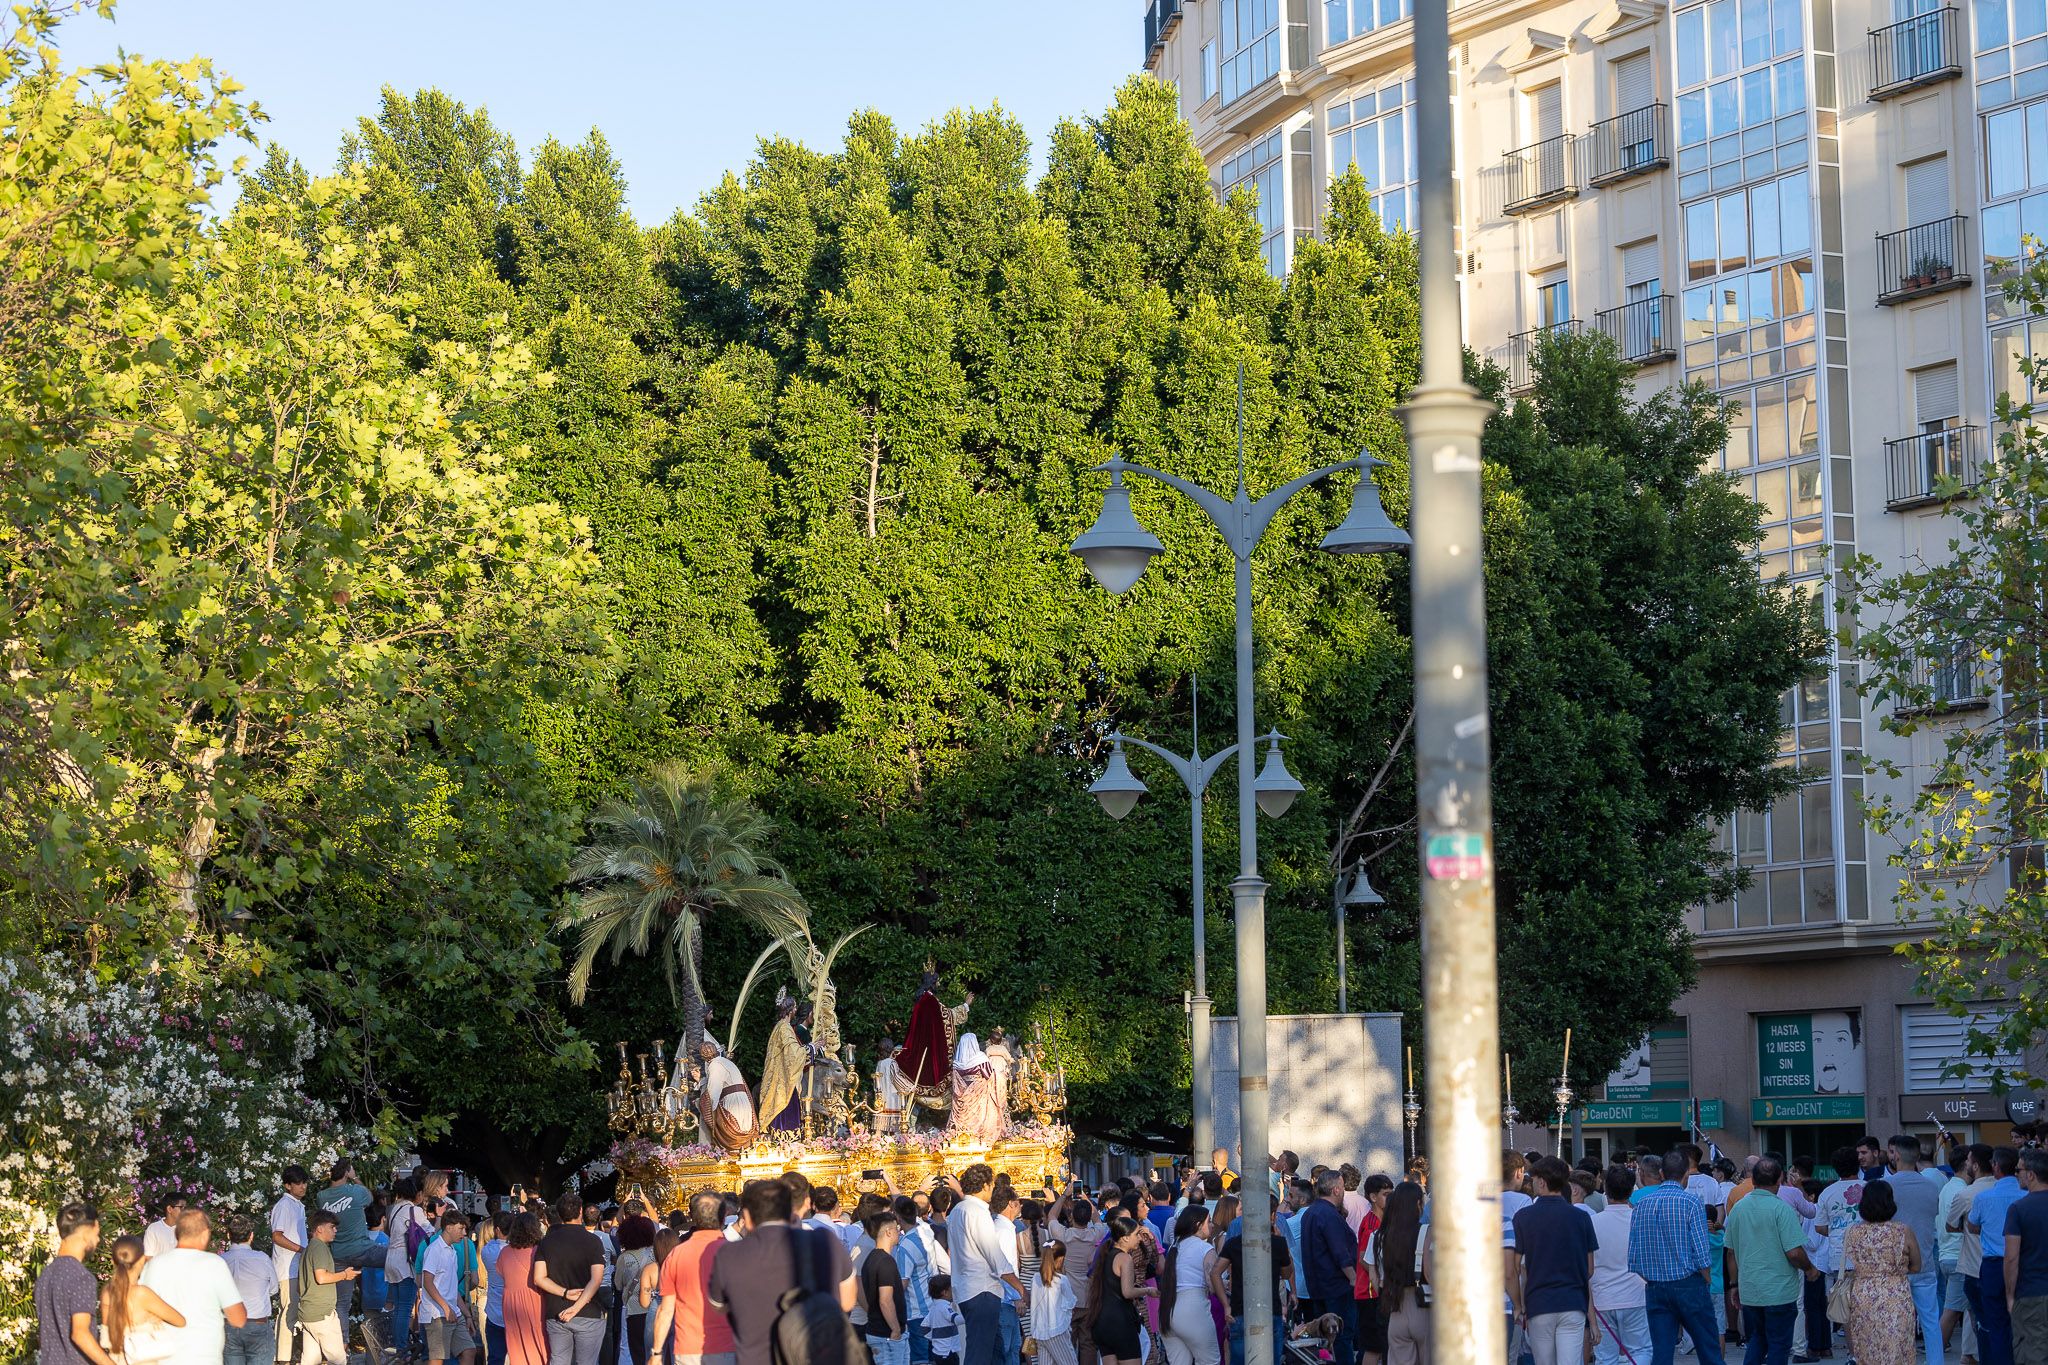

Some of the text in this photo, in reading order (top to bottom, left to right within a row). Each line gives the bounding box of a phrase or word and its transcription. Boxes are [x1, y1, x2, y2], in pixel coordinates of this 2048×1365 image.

[1771, 1025, 1799, 1036] HASTA
[1766, 1041, 1806, 1053] 12 MESES
[1779, 1058, 1793, 1070] SIN
[1763, 1074, 1810, 1087] INTERESES
[1590, 1107, 1633, 1119] CareDENT
[1775, 1102, 1823, 1116] CareDENT
[1832, 1108, 1852, 1116] Dental
[1944, 1101, 1977, 1118] KUBE
[2011, 1101, 2035, 1113] KUBE
